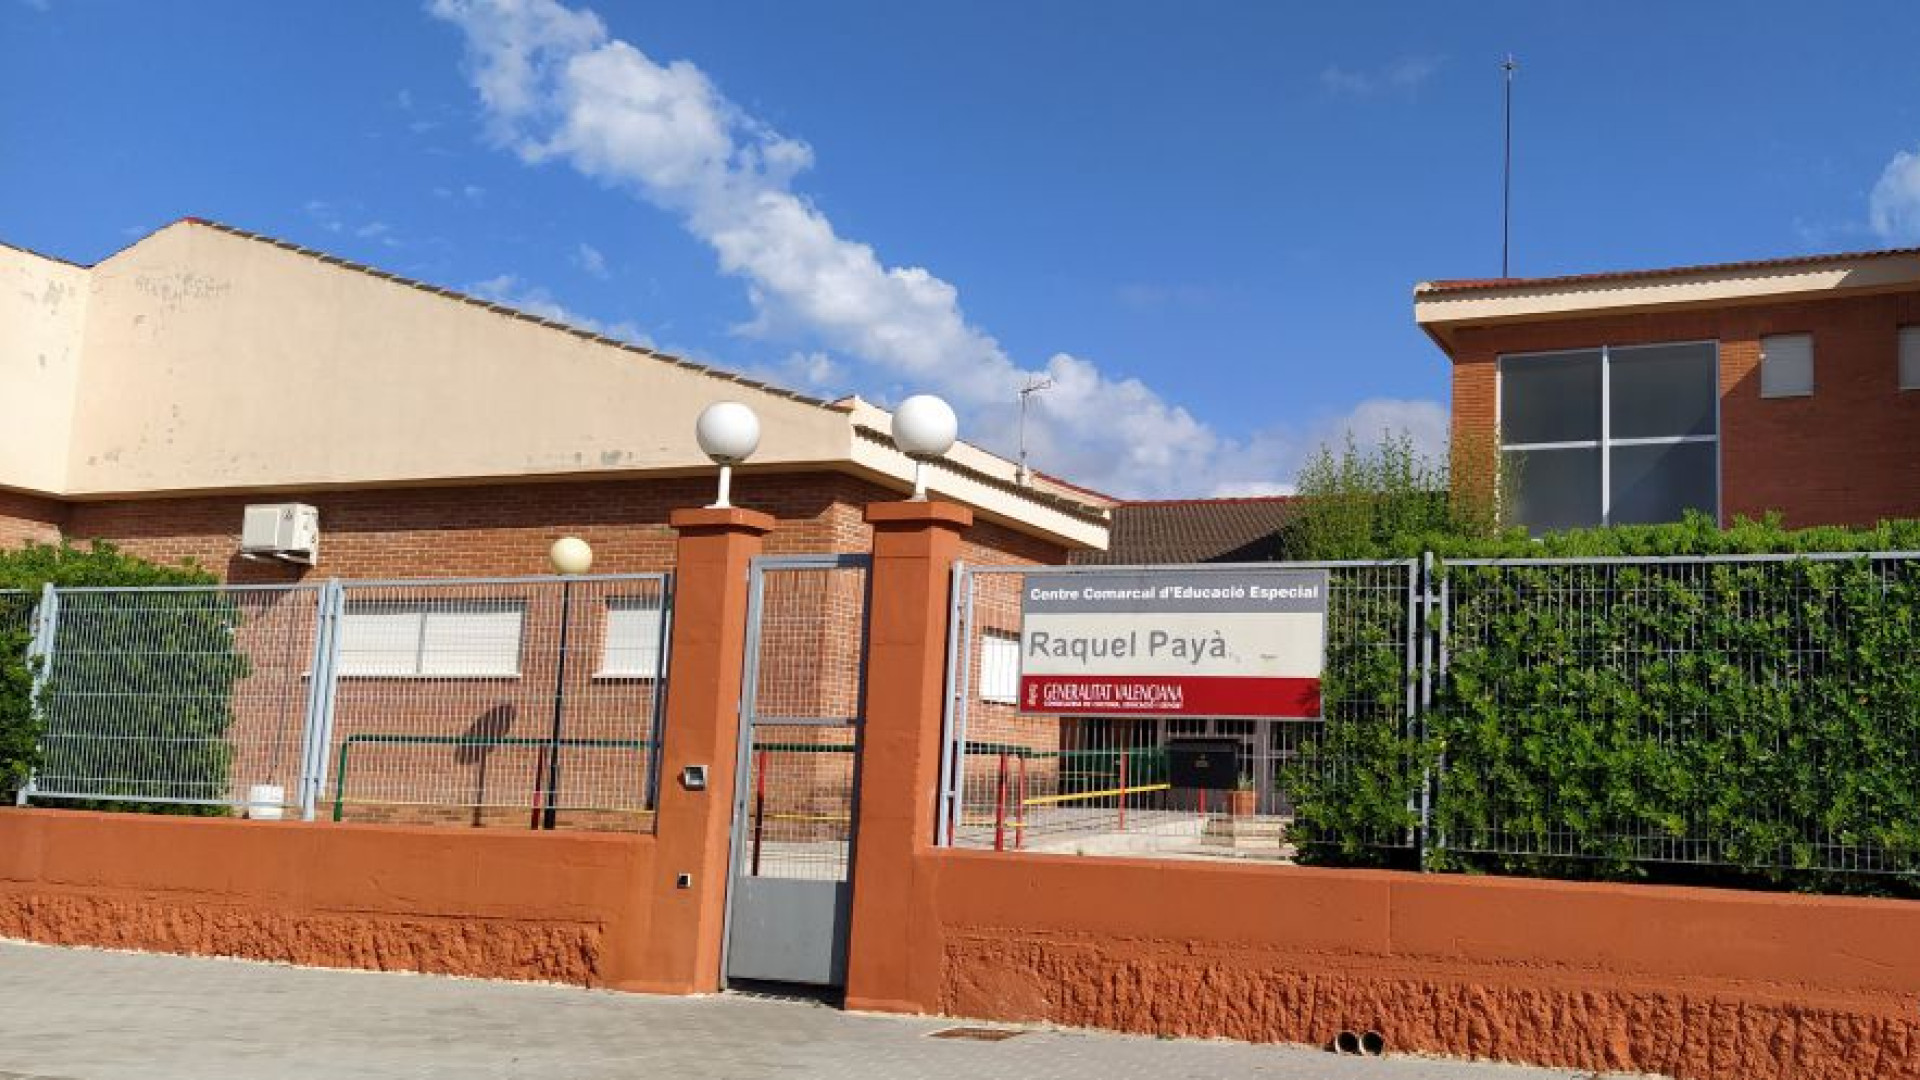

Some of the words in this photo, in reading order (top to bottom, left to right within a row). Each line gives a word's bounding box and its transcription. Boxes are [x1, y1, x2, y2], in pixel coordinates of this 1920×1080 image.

[1030, 588, 1079, 600] Centre
[1082, 587, 1156, 600] Comarcal
[1159, 585, 1245, 599] d'Educació
[1250, 586, 1319, 600] Especial
[1029, 631, 1136, 665] Raquel
[1149, 630, 1226, 665] Payà
[1043, 684, 1112, 701] GENERALITAT
